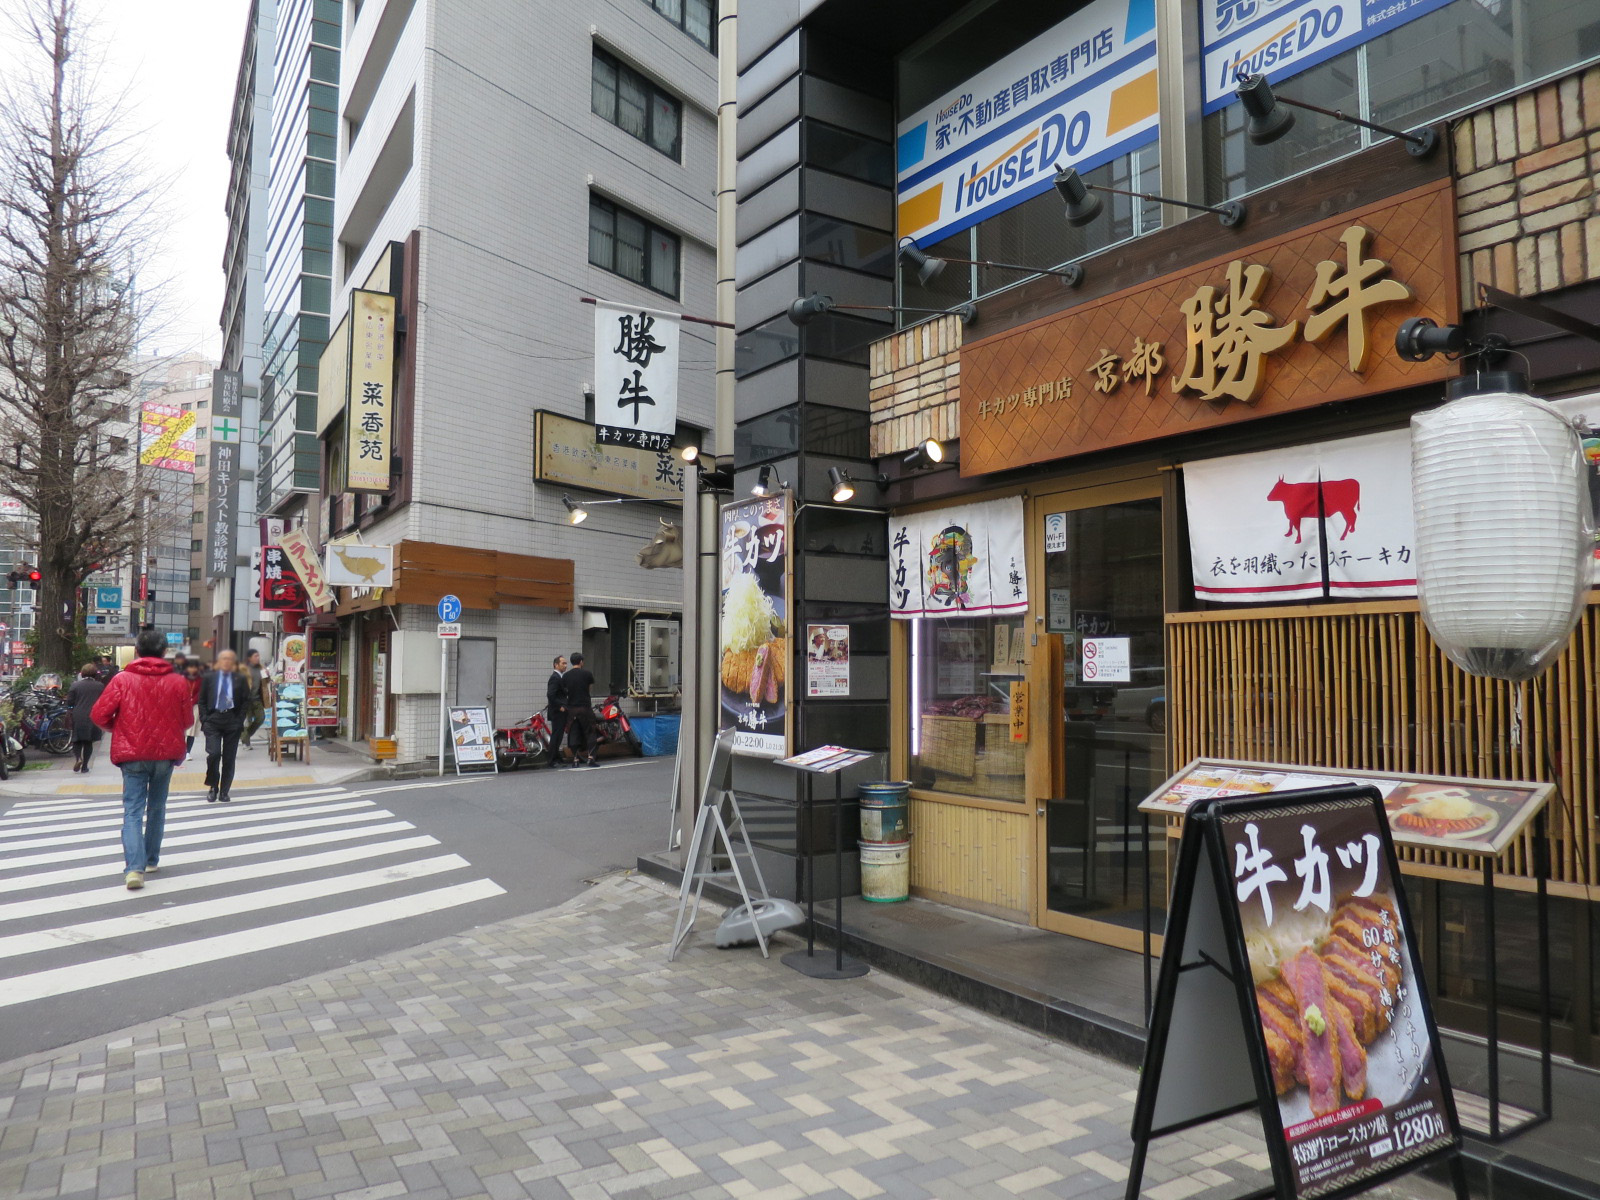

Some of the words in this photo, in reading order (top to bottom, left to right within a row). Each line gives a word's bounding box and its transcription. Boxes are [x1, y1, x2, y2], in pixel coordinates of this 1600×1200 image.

[978, 377, 1073, 420] 牛カツ専門店
[1086, 337, 1165, 396] 京都
[1172, 226, 1414, 402] 勝牛
[613, 311, 666, 425] 勝牛
[360, 382, 384, 461] 菜香苑
[598, 426, 671, 450] 牛カツ専門店
[213, 446, 232, 573] 神田キリスト教診療所
[723, 525, 784, 575] 牛カツ
[1046, 533, 1065, 541] Wi-Fi
[1046, 541, 1066, 549] 使えます
[265, 549, 282, 579] 串焼
[289, 541, 324, 597] ラーメン
[893, 526, 911, 610] 牛カツ
[443, 603, 452, 619] P
[1013, 691, 1025, 730] 営業中
[1235, 823, 1381, 928] 牛カツ
